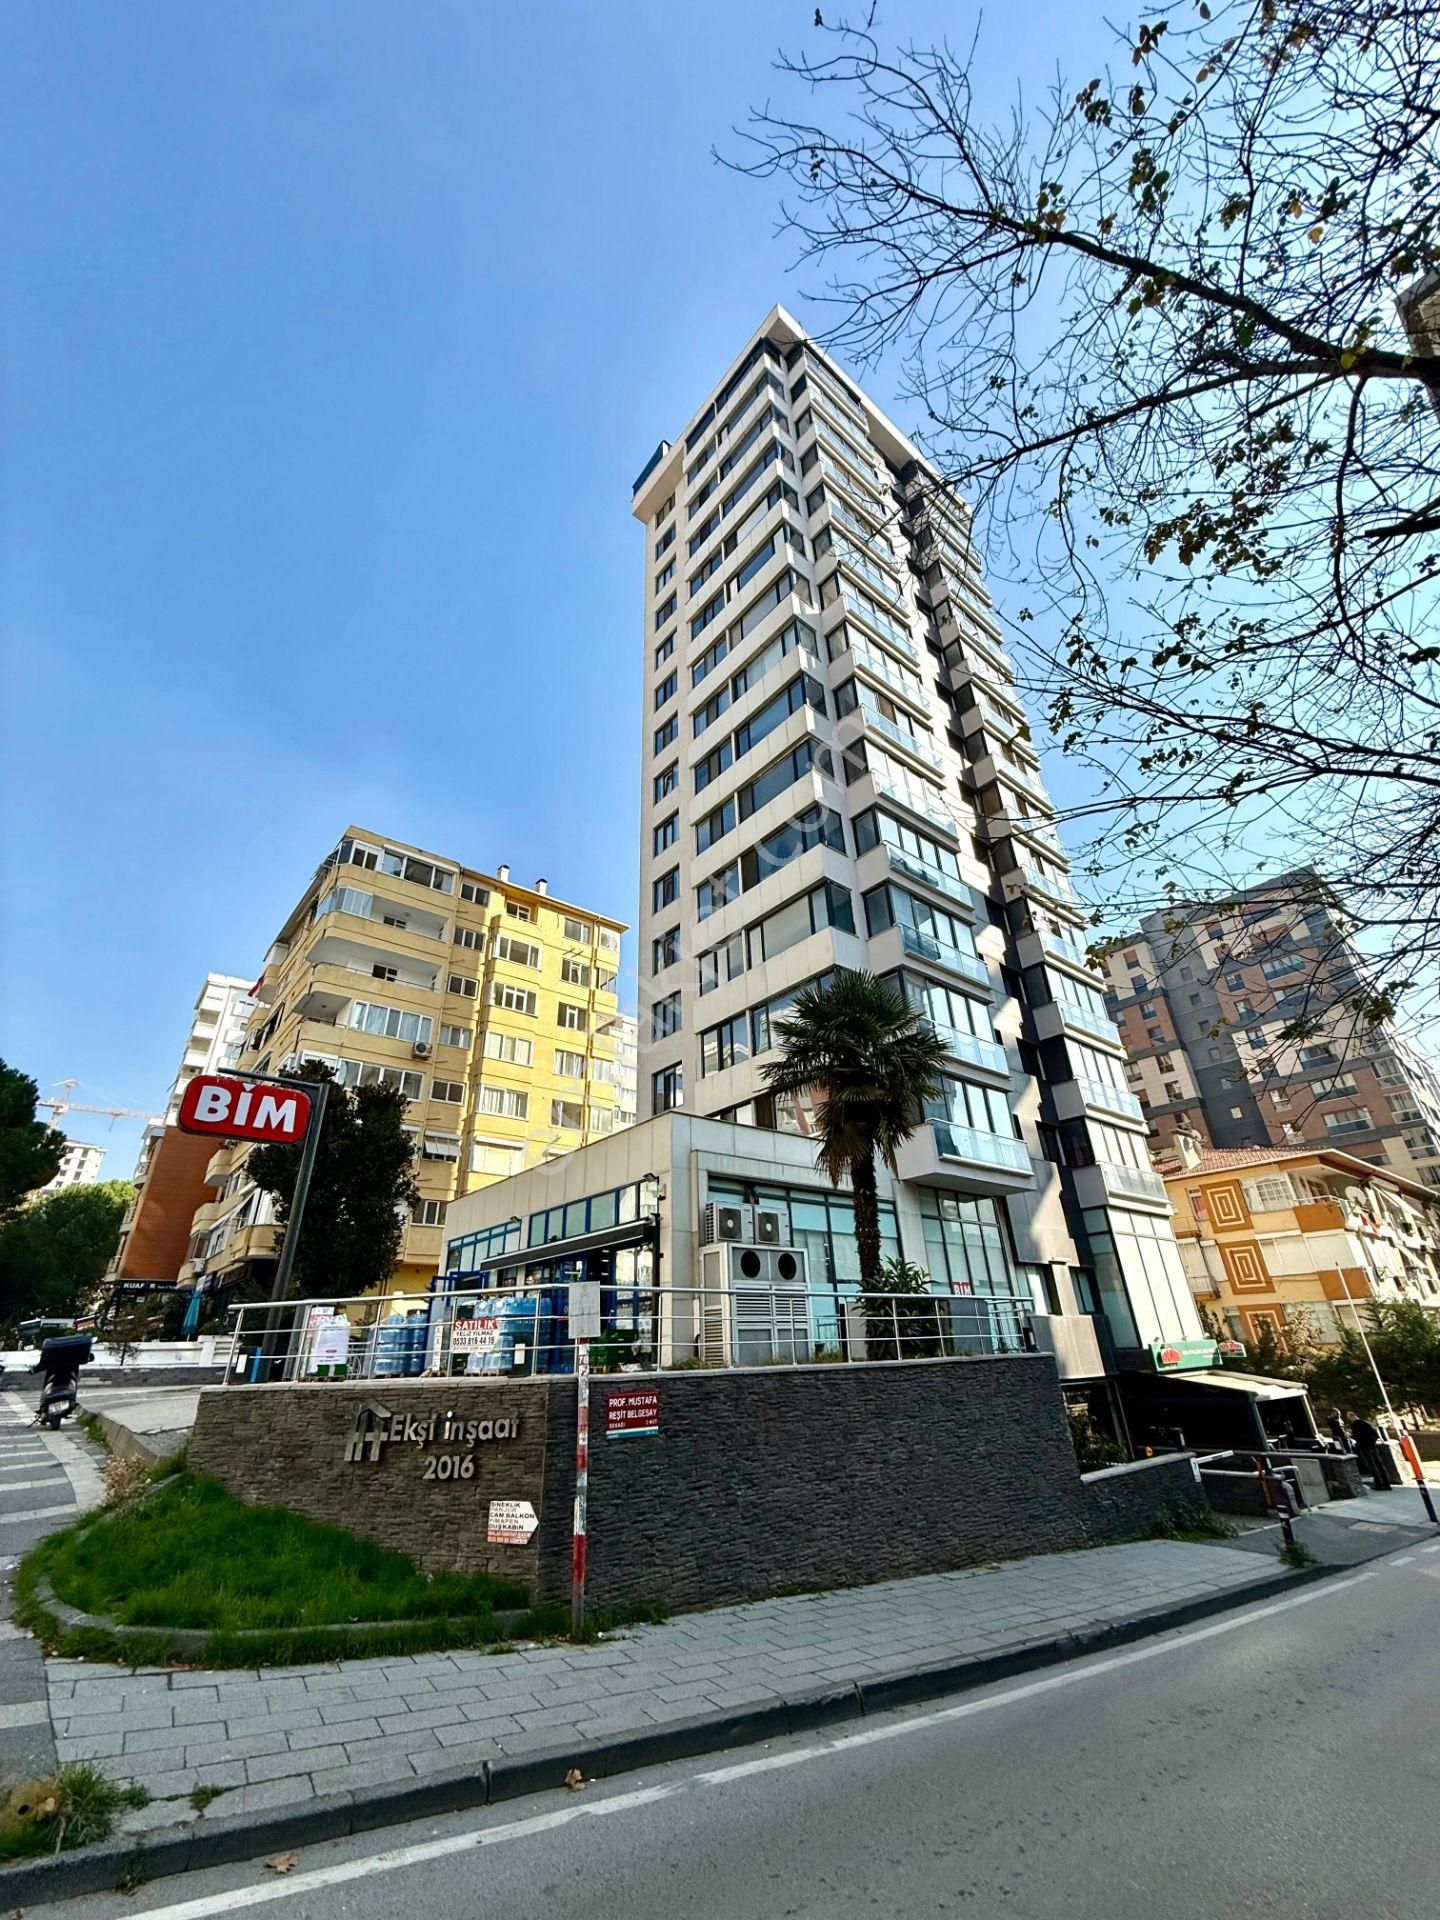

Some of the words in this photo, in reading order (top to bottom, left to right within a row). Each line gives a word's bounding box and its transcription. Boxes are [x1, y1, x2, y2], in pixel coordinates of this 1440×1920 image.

[194, 1083, 297, 1133] BİM
[455, 1320, 494, 1329] SATILIK
[453, 1337, 466, 1345] 0533
[609, 1398, 627, 1407] PROF.
[628, 1396, 657, 1406] MUSTAFA
[609, 1409, 626, 1420] REŞİT
[627, 1409, 657, 1418] BELGESAY
[422, 1455, 474, 1479] 2016
